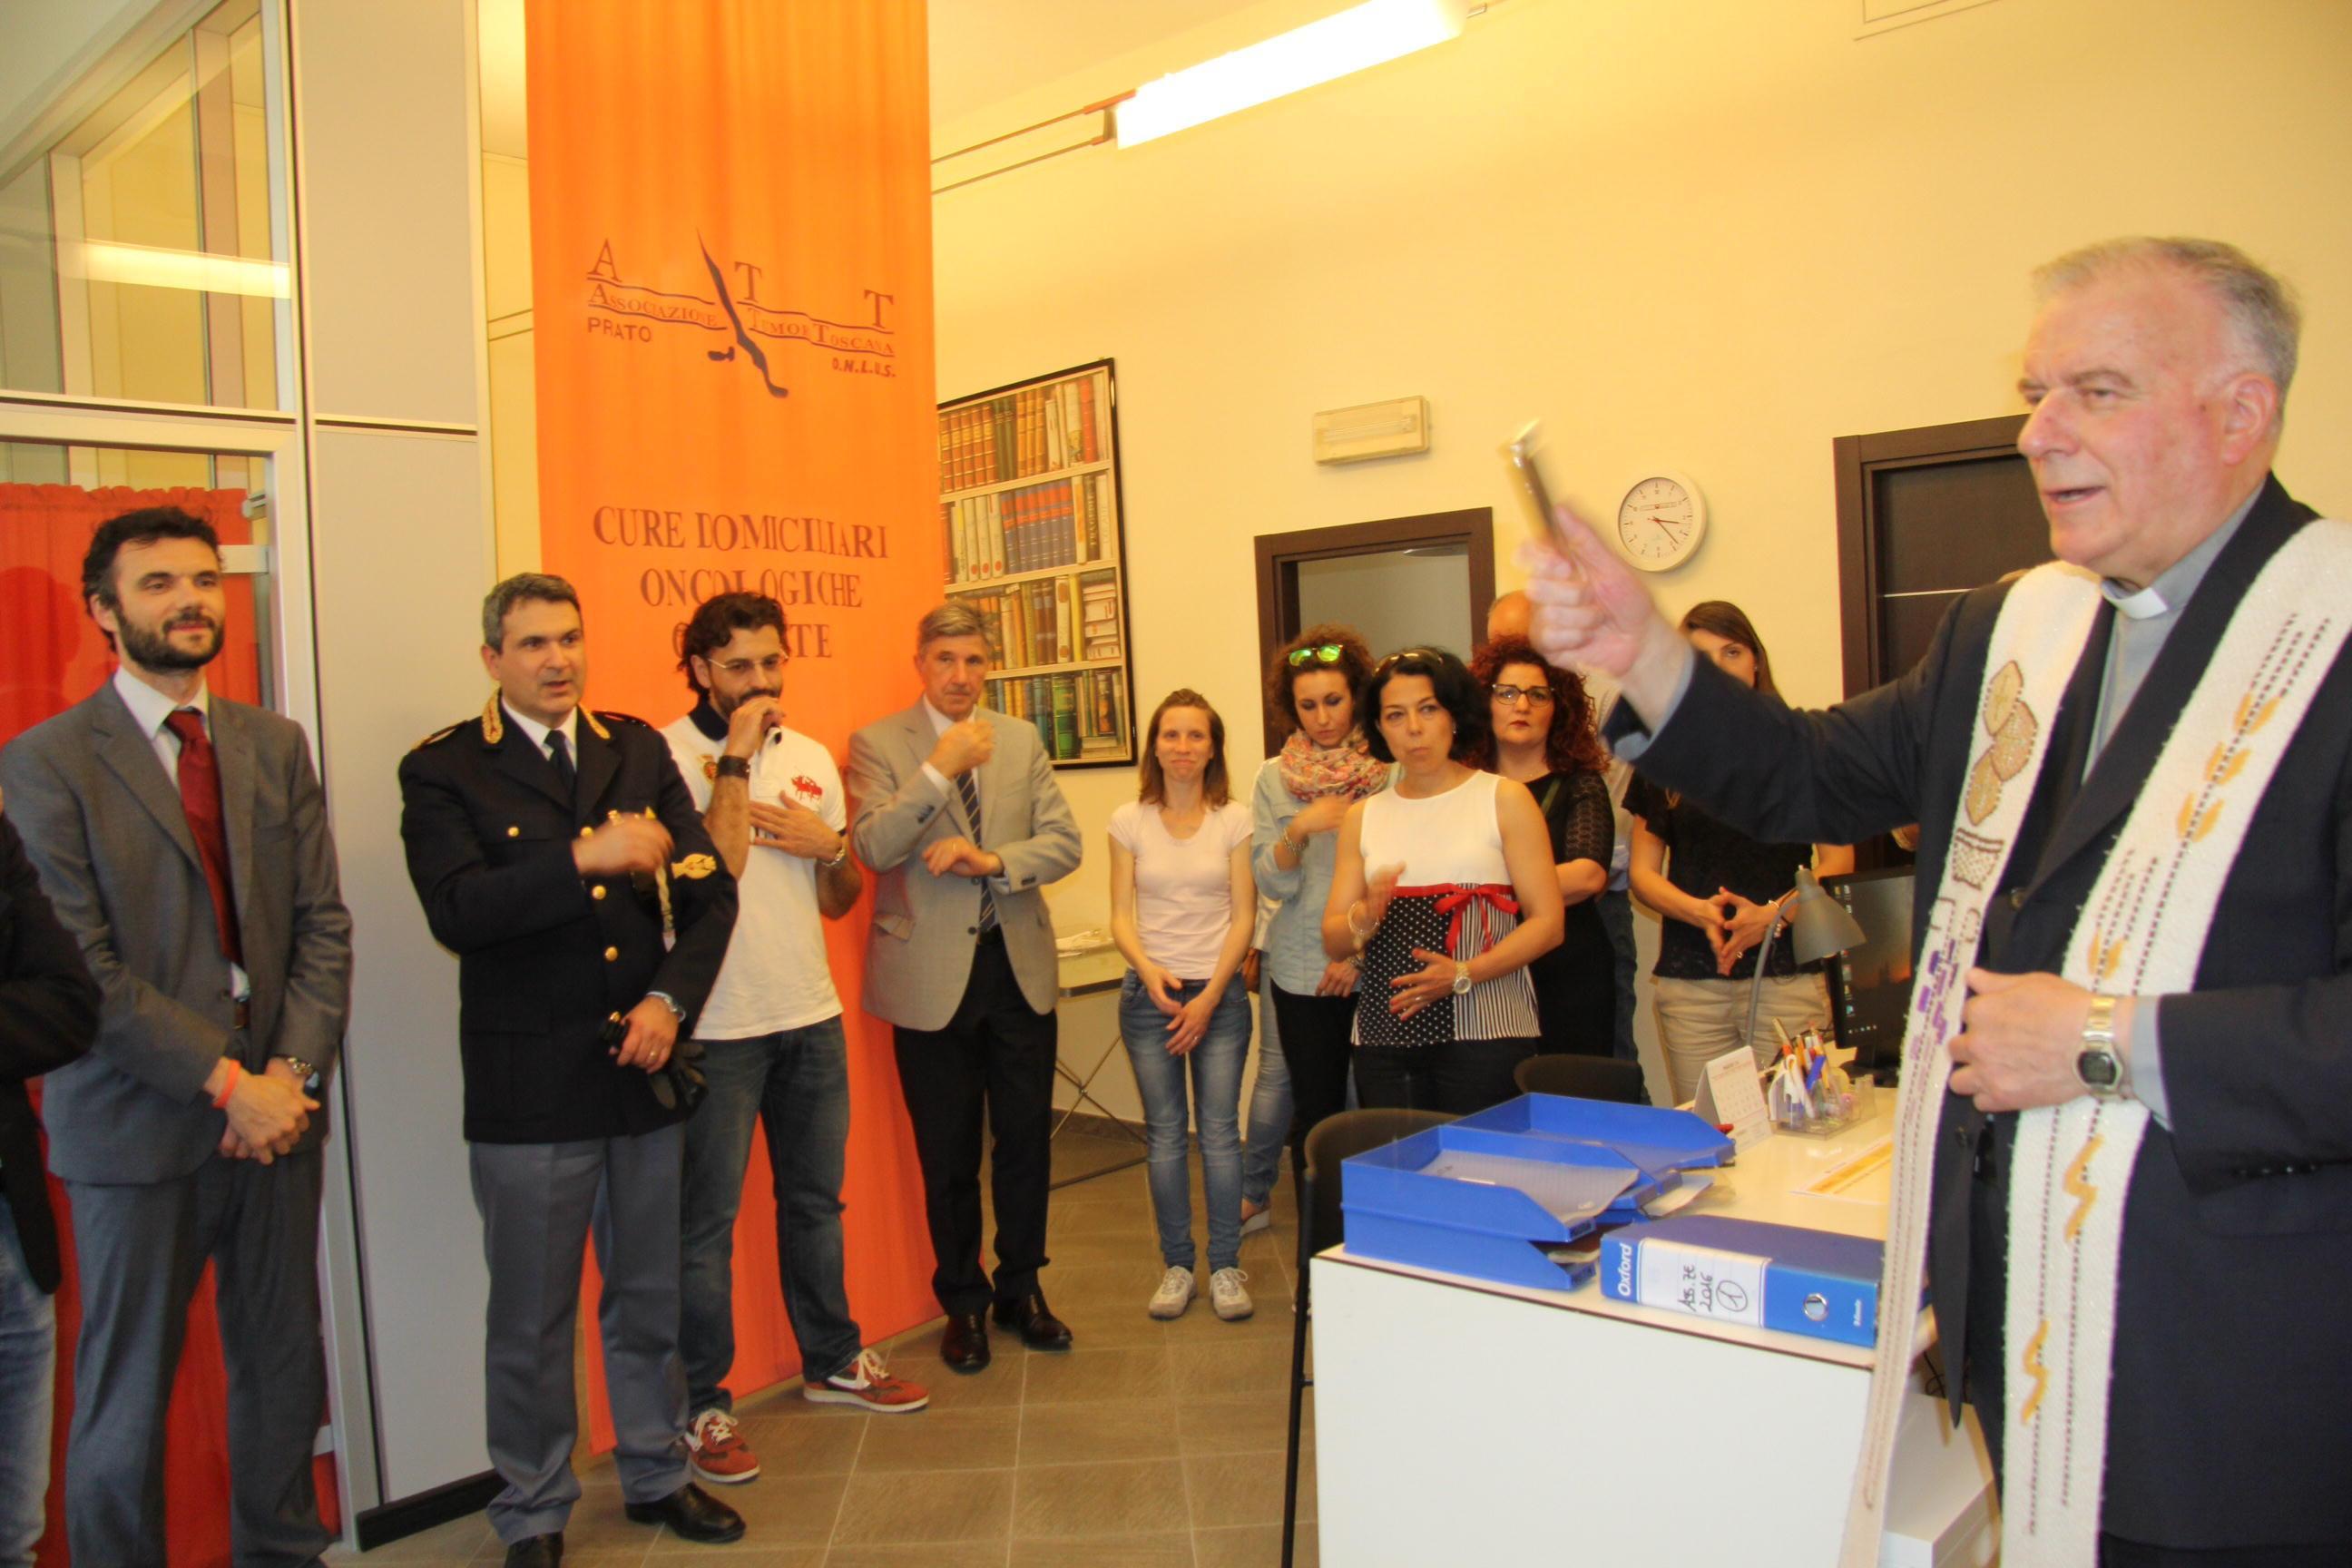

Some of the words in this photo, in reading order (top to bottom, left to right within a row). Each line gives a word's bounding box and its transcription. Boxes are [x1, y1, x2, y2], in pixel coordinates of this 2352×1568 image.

[587, 317, 652, 343] PRATO
[593, 505, 686, 549] CURE
[1617, 1242, 1633, 1297] Oxford
[1699, 1271, 1713, 1312] 2016
